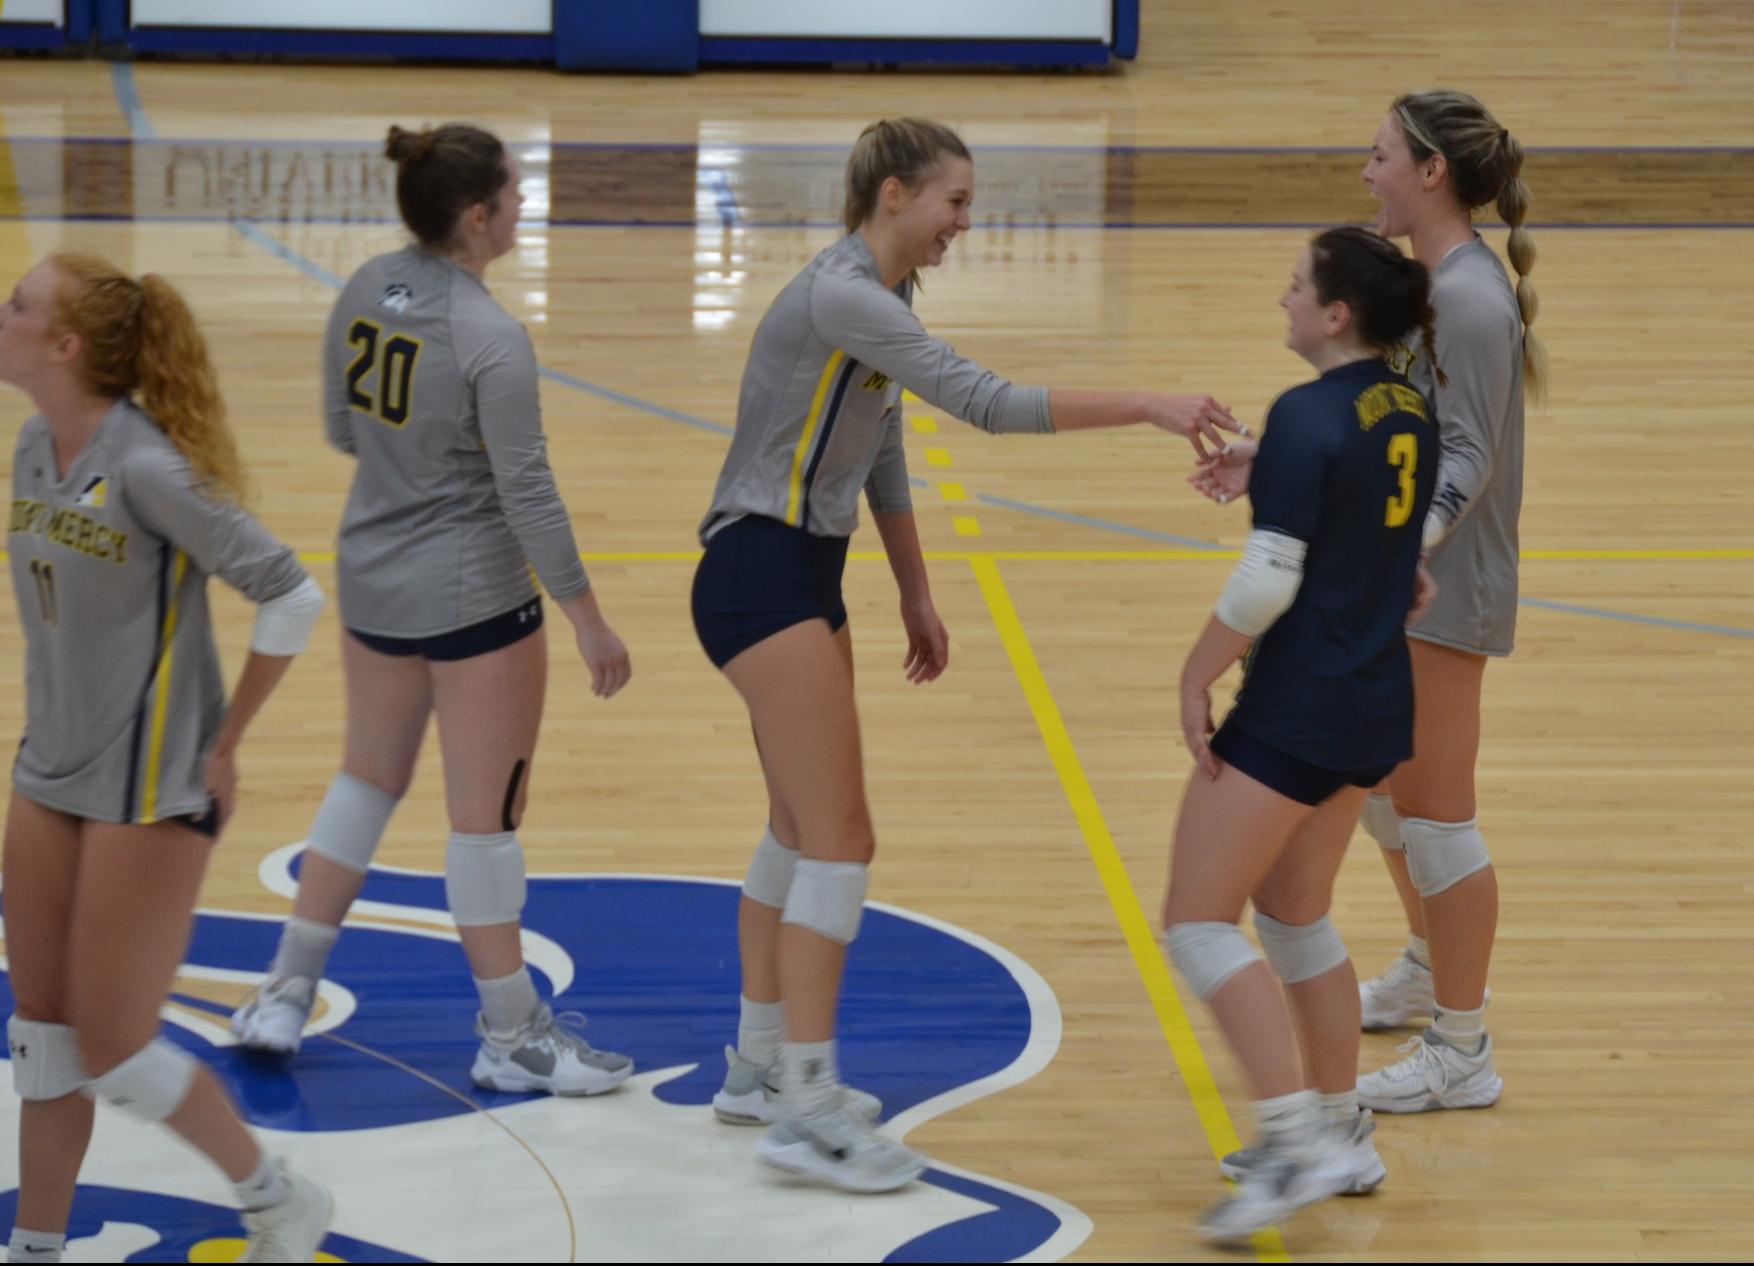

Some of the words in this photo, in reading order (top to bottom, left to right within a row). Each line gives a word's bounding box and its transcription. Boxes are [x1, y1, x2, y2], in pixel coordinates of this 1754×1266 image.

[346, 316, 424, 429] 20
[1384, 432, 1419, 528] 3
[49, 507, 129, 565] MERCY
